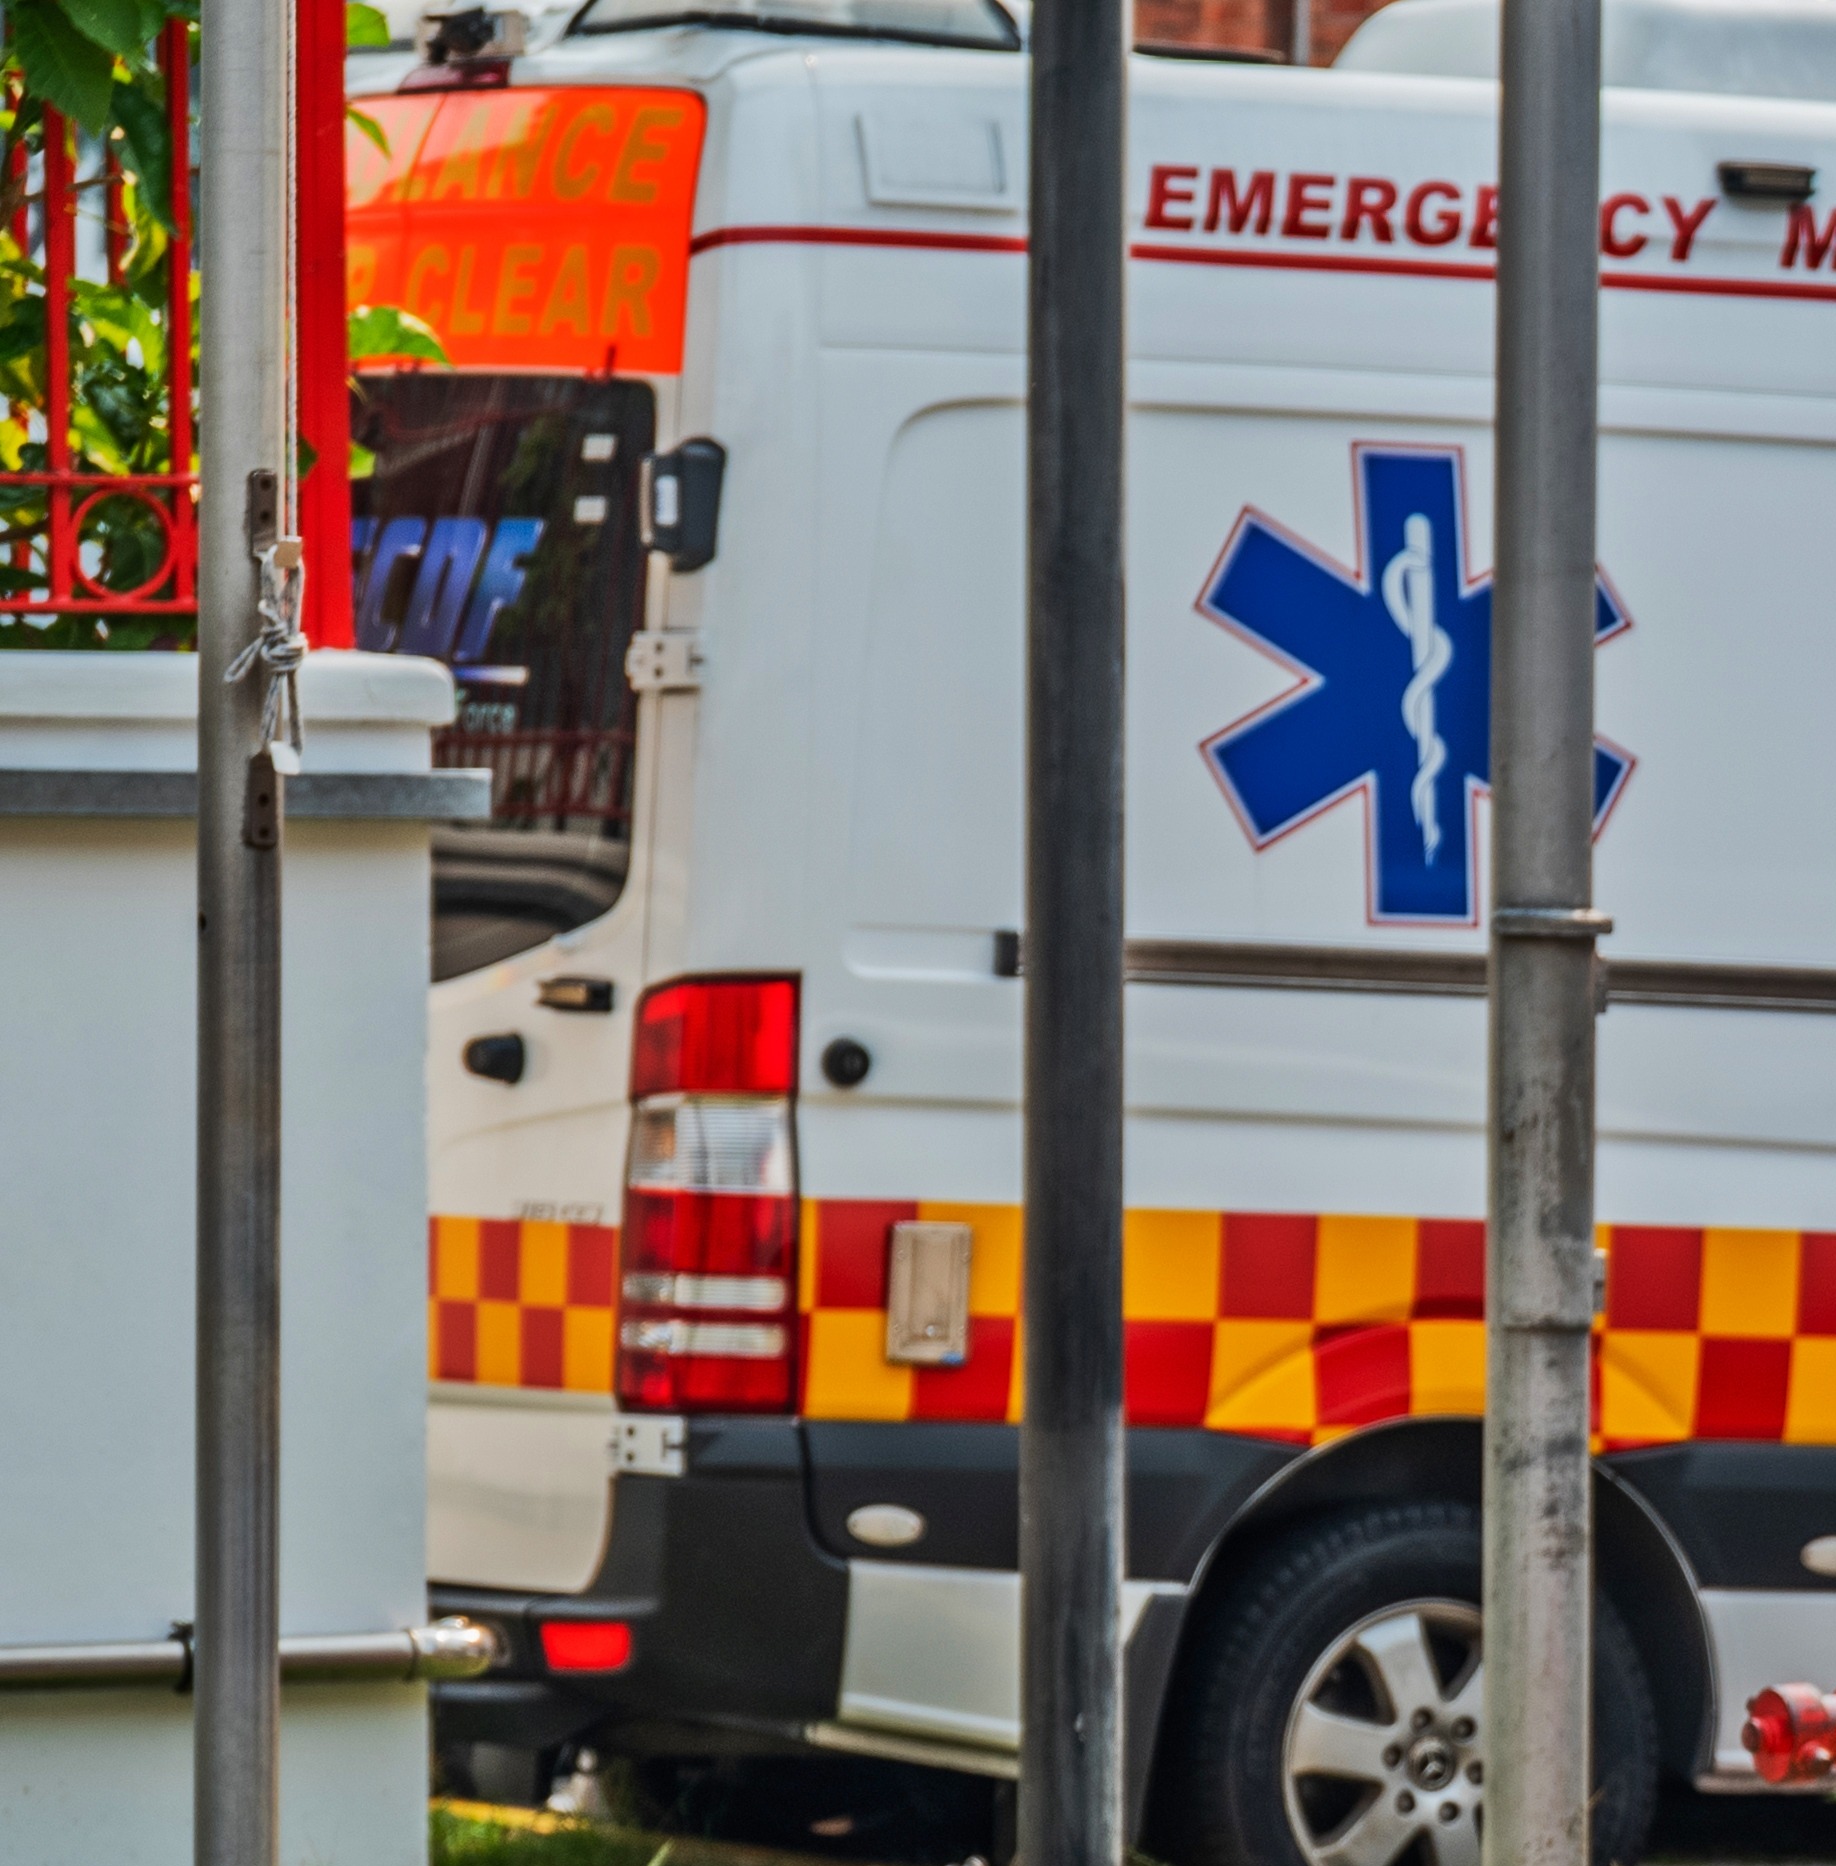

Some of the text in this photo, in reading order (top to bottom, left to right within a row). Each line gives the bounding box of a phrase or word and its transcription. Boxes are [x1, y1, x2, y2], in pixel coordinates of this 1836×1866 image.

[1143, 162, 1717, 264] EMERGECY
[402, 242, 662, 338] CLEAR
[350, 515, 547, 662] CDF
